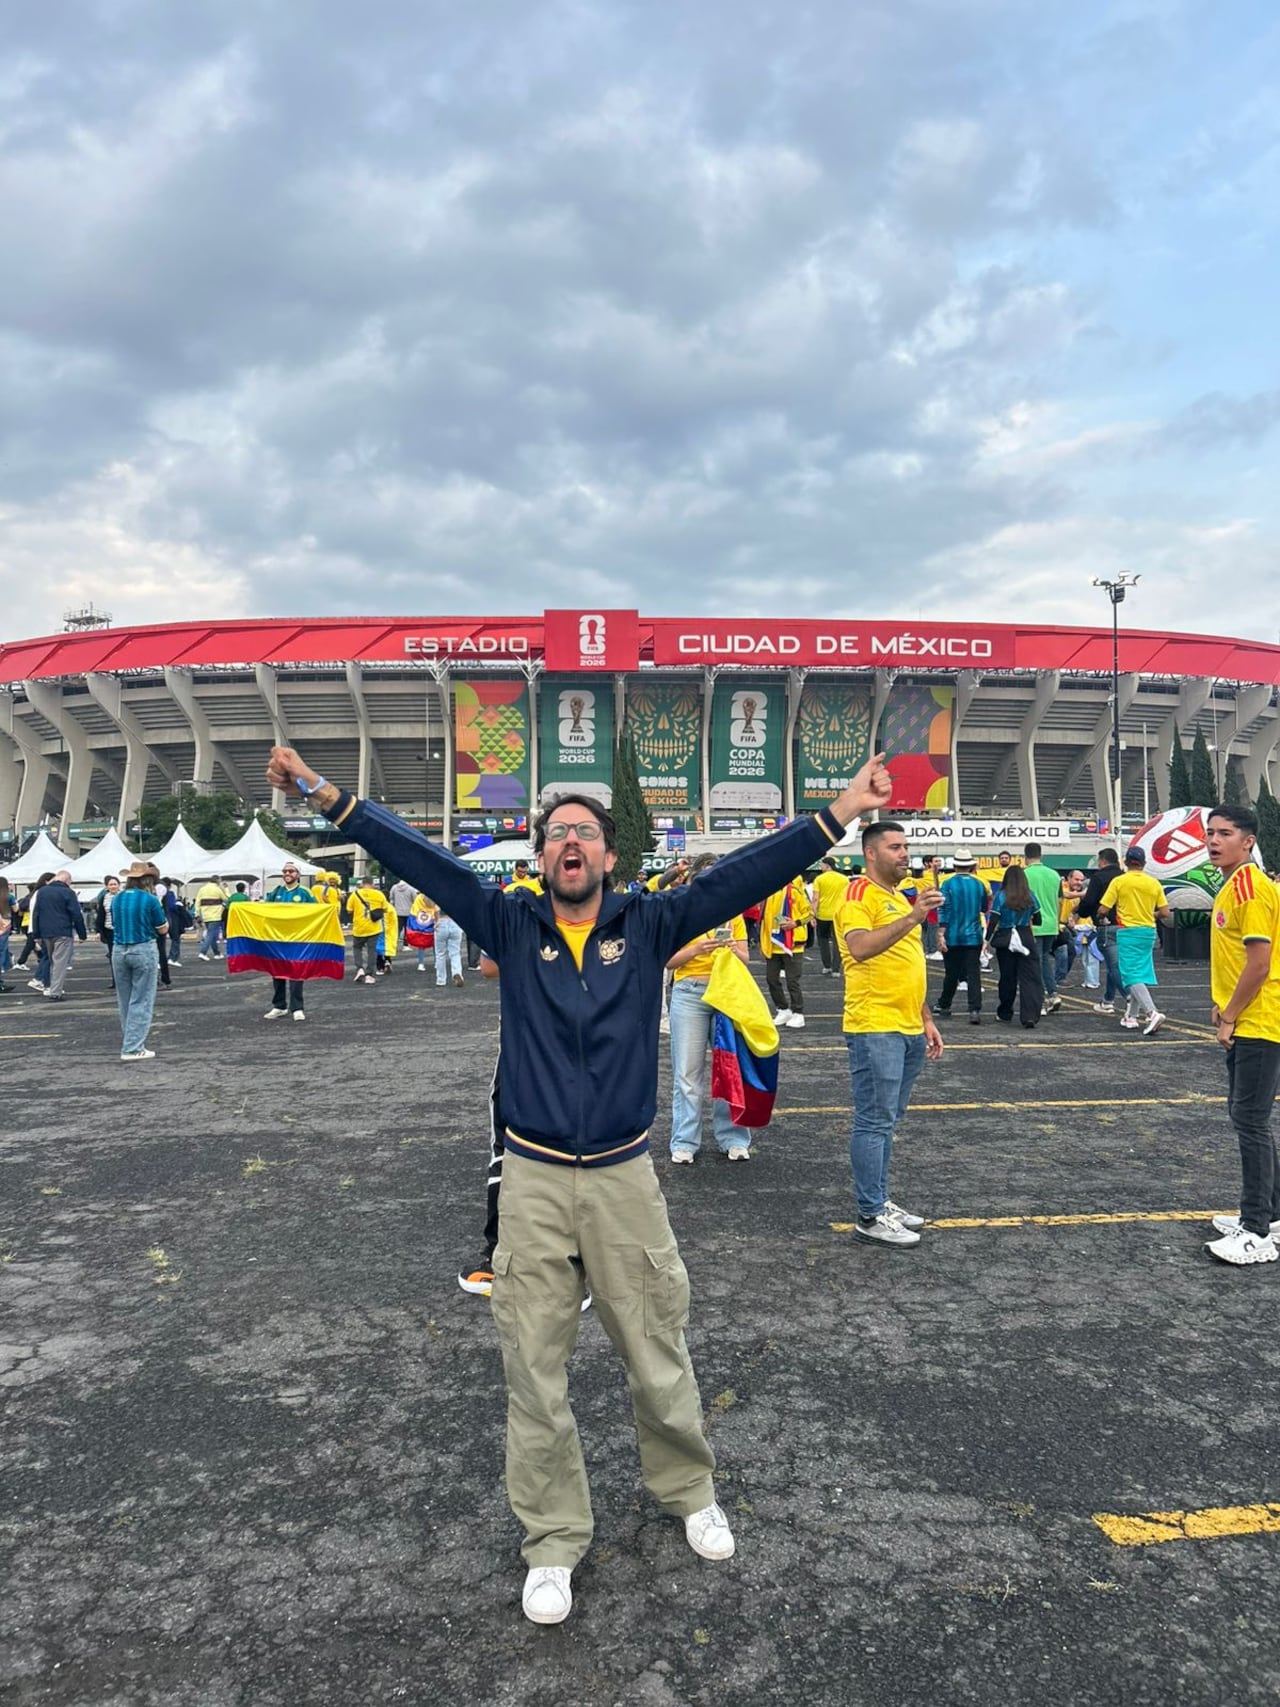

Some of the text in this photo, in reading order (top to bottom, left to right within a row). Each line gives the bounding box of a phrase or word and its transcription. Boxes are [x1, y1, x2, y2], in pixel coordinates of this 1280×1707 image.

[404, 637, 528, 653] ESTADIO
[679, 632, 992, 657] CIUDAD DE MÉXICO
[559, 755, 595, 764] 2026
[729, 749, 766, 760] COPA
[729, 760, 766, 768] MUNDIAL
[729, 767, 766, 777] 2026
[638, 776, 688, 788] SOMOS
[805, 777, 853, 789] WE AR
[676, 789, 688, 797] DE
[961, 827, 985, 837] DE
[991, 824, 1060, 837] MÉXICO
[470, 861, 504, 872] COPA
